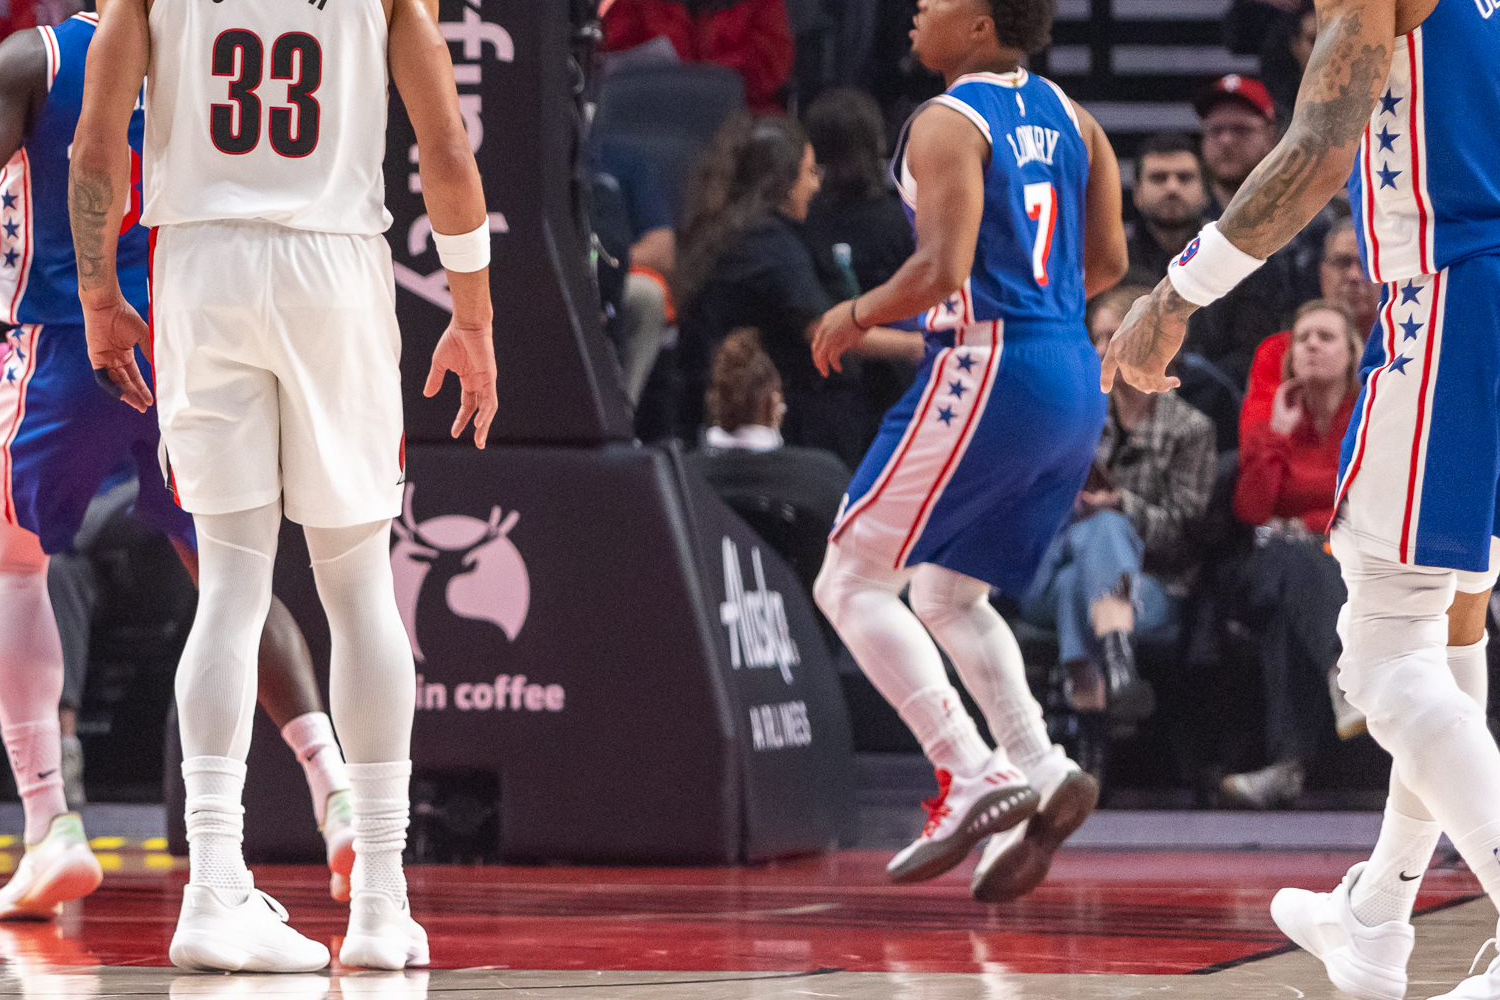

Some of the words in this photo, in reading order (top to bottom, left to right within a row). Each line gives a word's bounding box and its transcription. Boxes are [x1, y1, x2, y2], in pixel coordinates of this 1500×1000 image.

[210, 28, 323, 158] 33
[1006, 125, 1060, 167] LOWRY
[1024, 182, 1058, 287] 7
[453, 673, 565, 711] coffee
